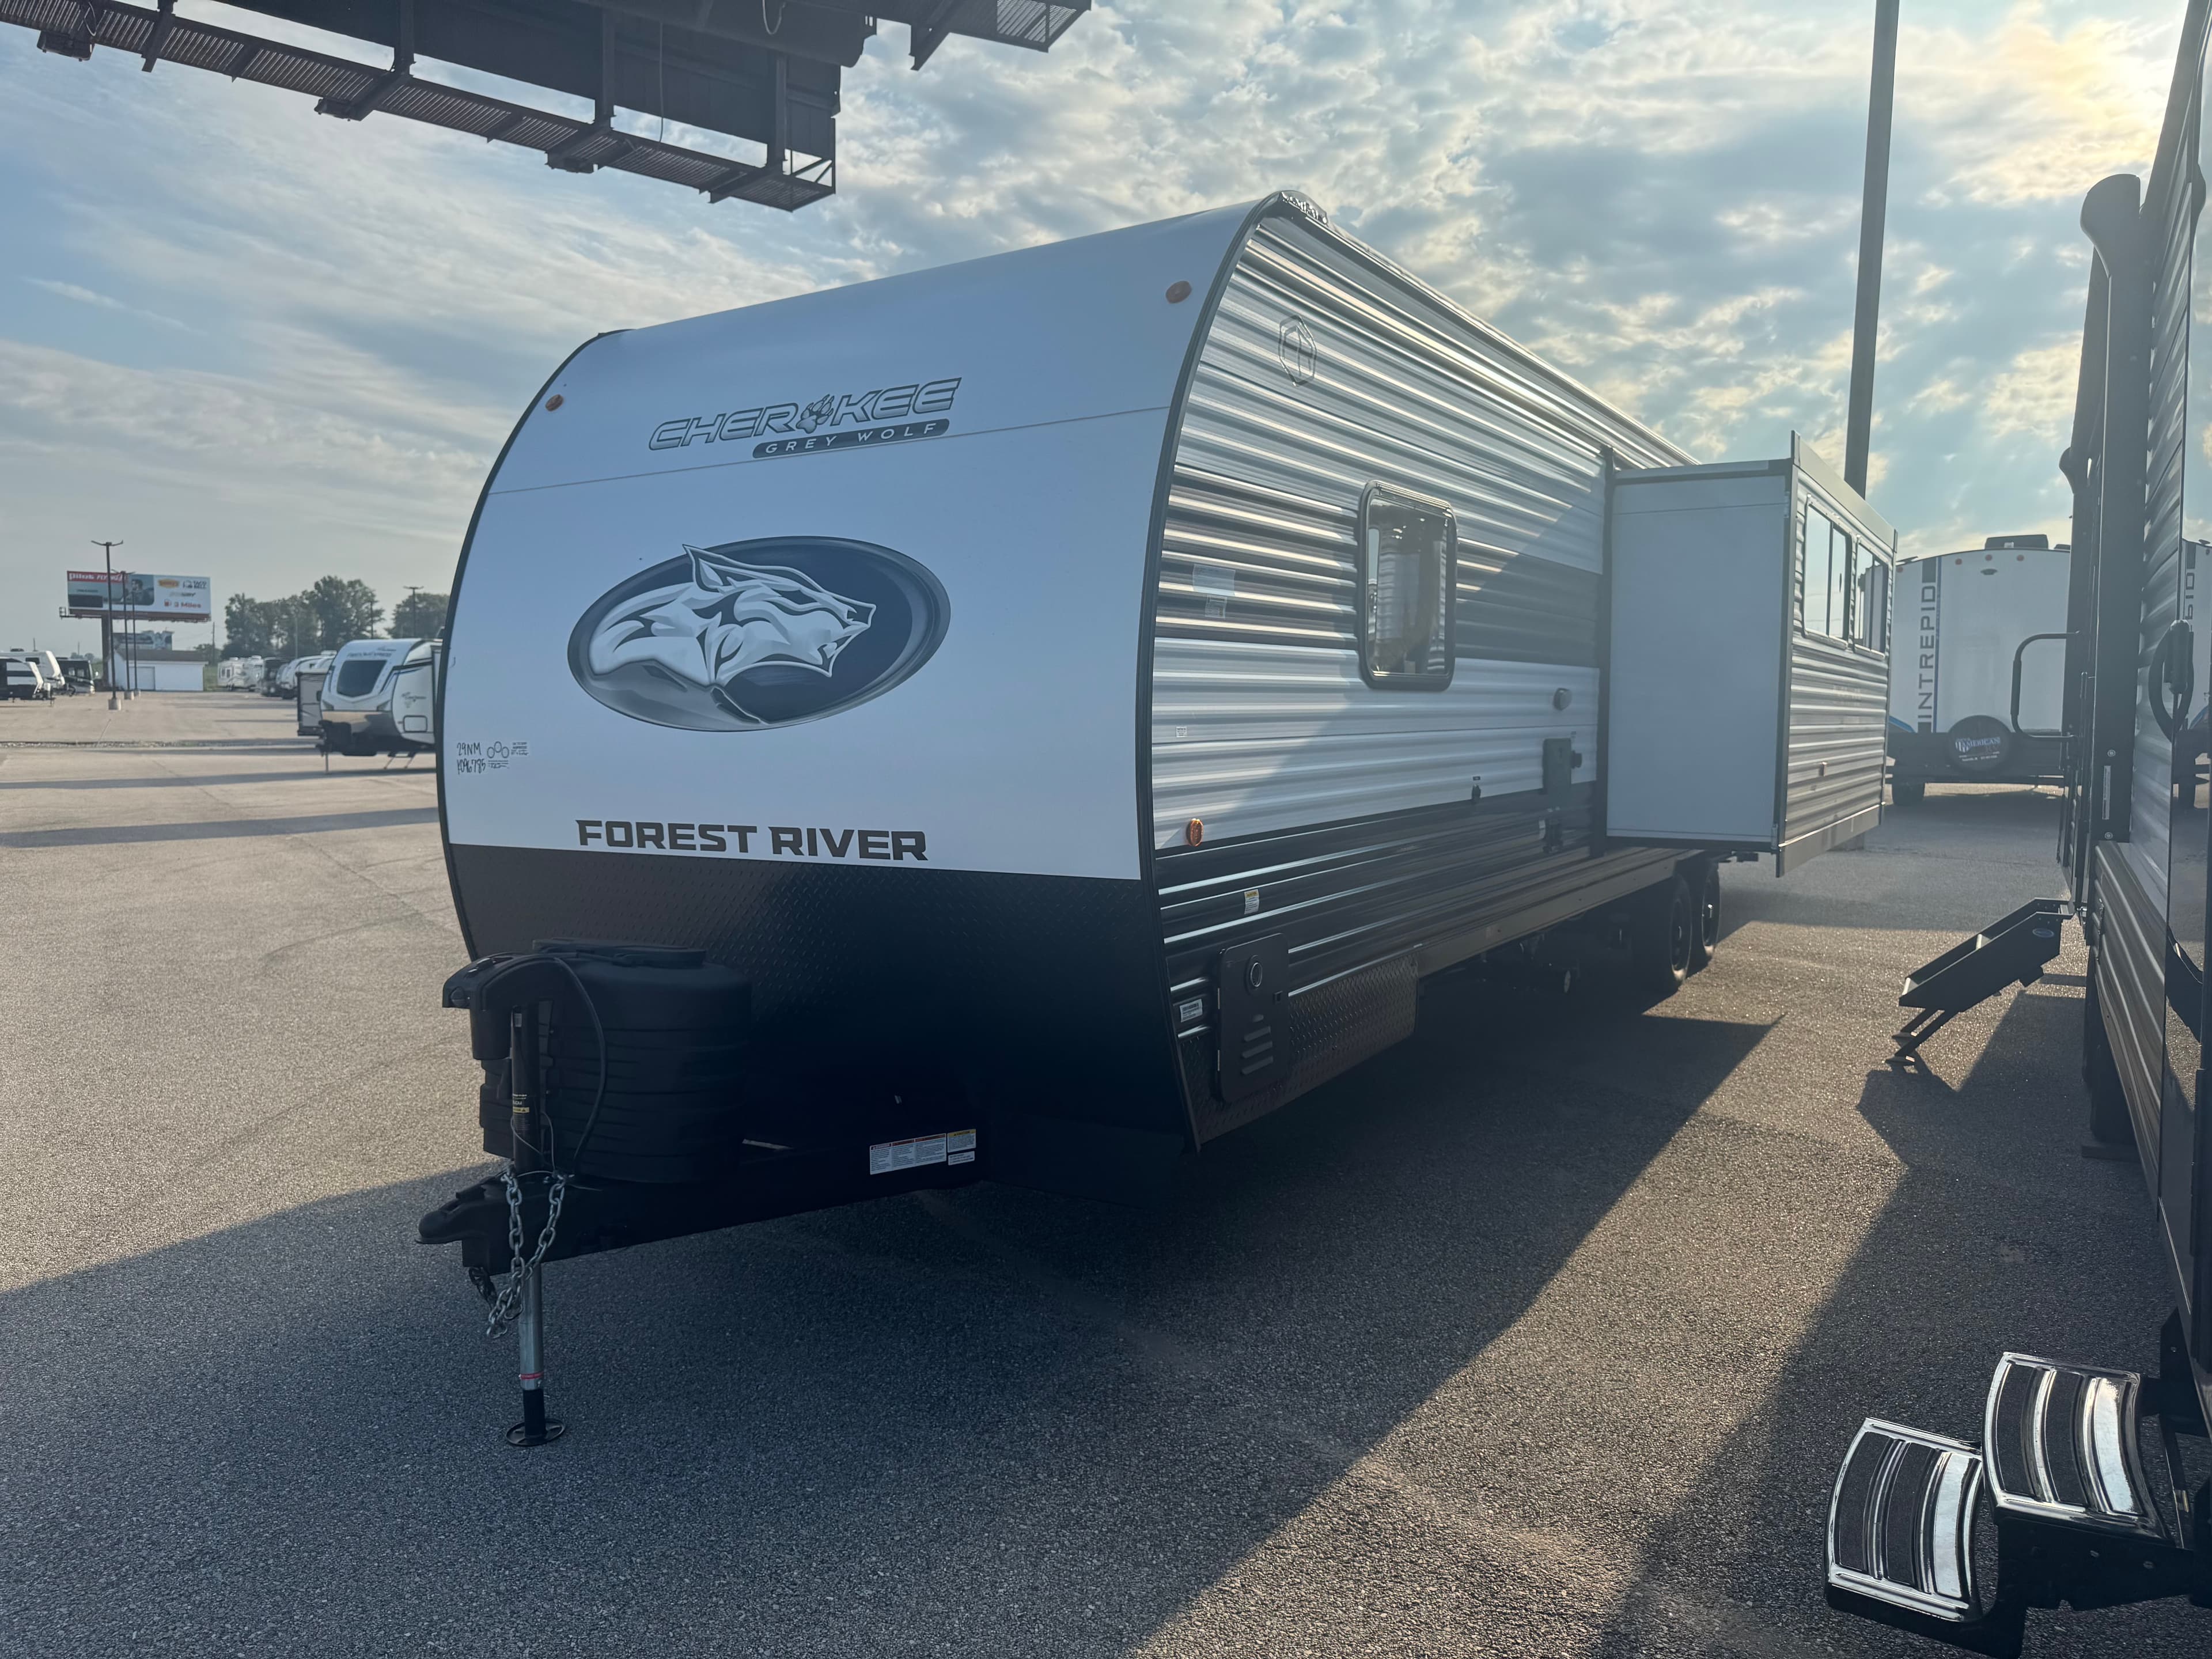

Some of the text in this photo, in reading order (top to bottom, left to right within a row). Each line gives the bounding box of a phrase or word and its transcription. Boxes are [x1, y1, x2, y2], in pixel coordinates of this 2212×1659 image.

[765, 423, 937, 453] GREY WOLF
[1918, 585, 1936, 718] INTREPID
[457, 742, 482, 756] 29NM
[575, 820, 929, 861] FOREST RIVER
